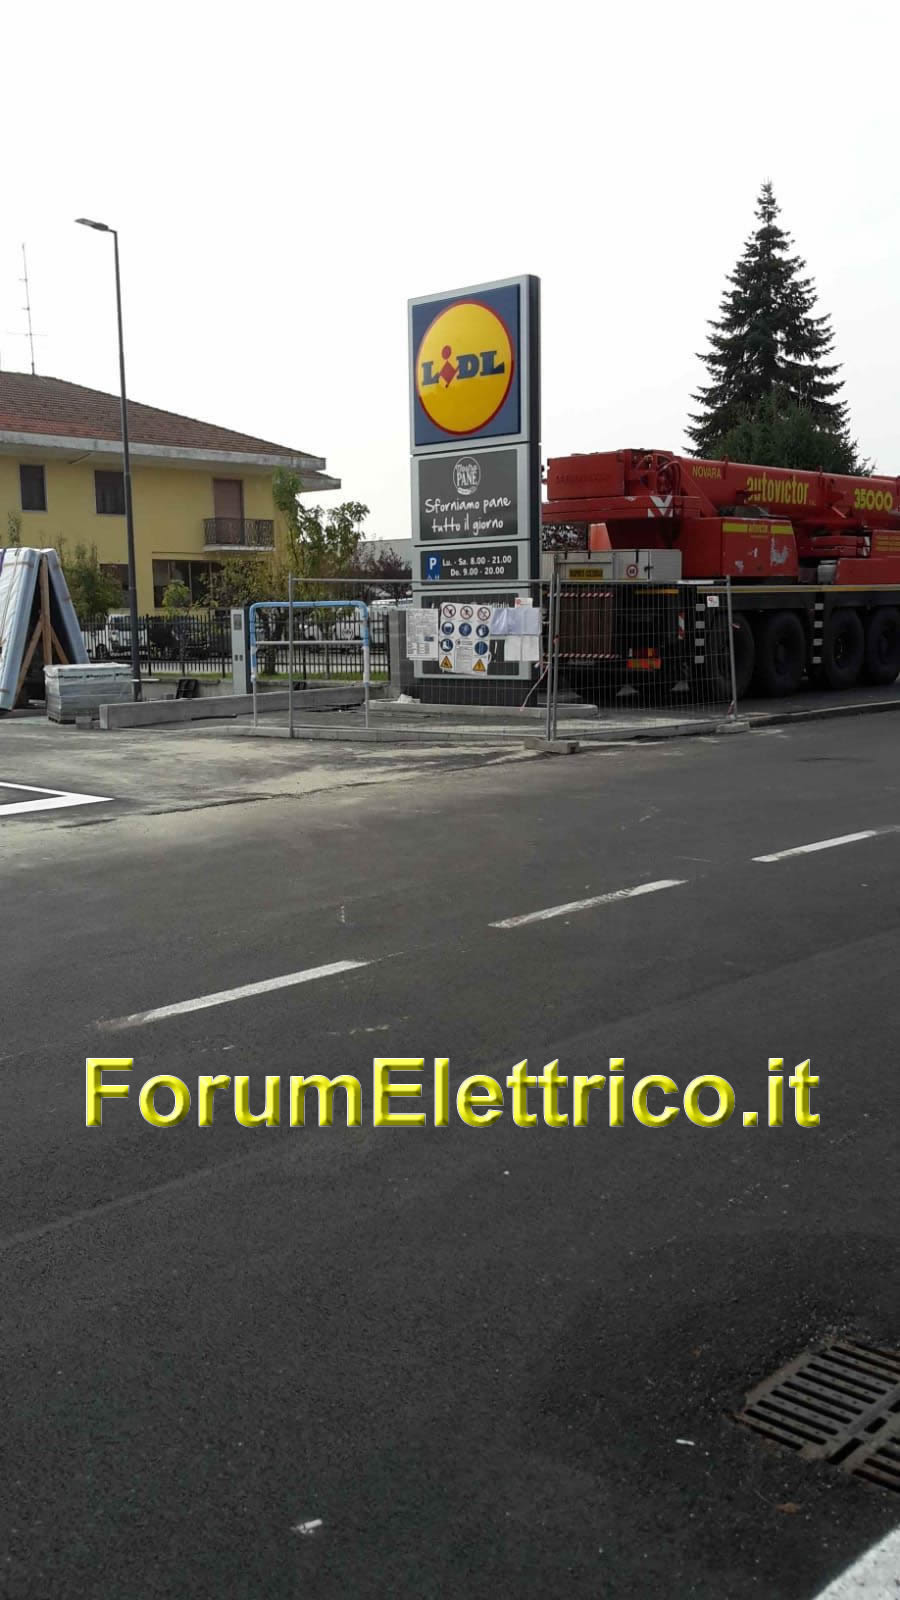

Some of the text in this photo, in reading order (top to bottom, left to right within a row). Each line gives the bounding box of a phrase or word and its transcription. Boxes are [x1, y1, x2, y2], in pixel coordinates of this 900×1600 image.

[456, 471, 478, 486] PANE
[692, 465, 721, 479] NOVARA
[746, 471, 809, 505] autovictor
[425, 497, 511, 513] Sforniamo pane
[854, 488, 893, 512] 35000
[432, 513, 504, 535] tutto il giorno
[429, 558, 437, 569] P
[492, 555, 512, 564] 21.00
[484, 566, 505, 575] 20.00
